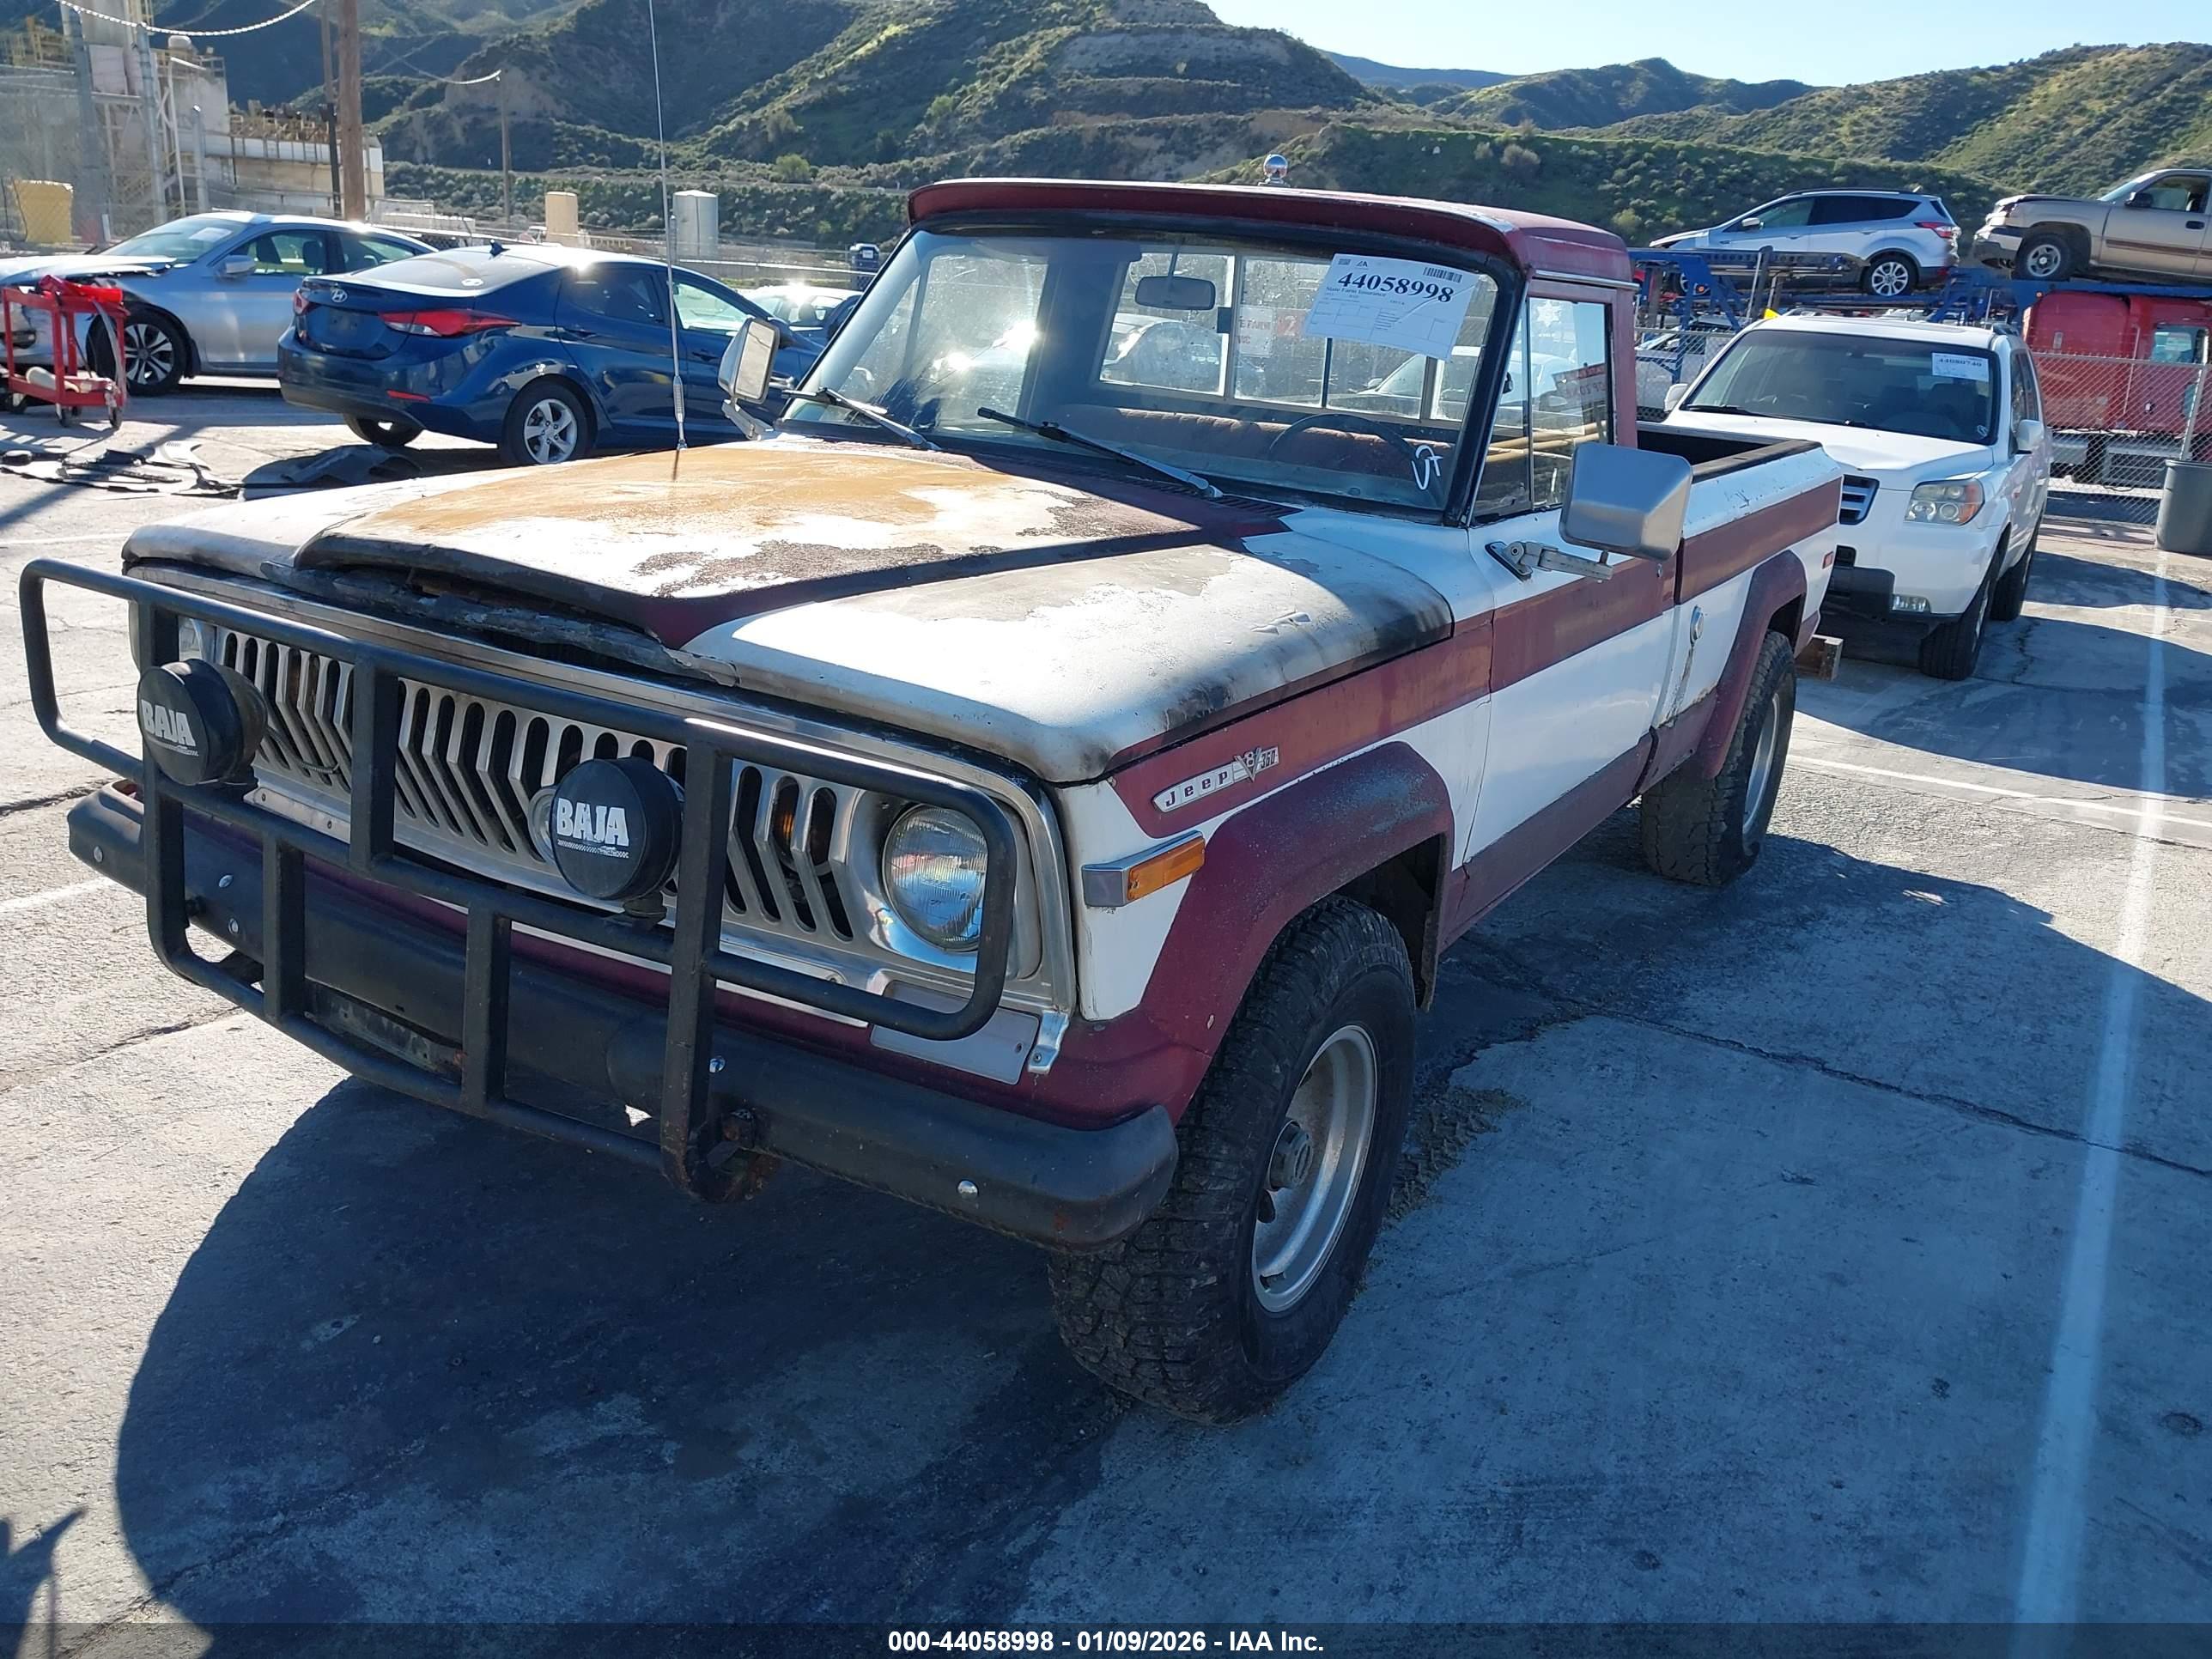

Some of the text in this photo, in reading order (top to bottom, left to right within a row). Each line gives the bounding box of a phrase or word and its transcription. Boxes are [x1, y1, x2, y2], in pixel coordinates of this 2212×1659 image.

[1338, 272, 1454, 302] 44058998
[1358, 289, 1387, 297] Insurance
[141, 699, 196, 746] BAJA
[1165, 771, 1228, 807] Jeep
[1260, 750, 1277, 769] 360
[557, 798, 629, 846] BAJA
